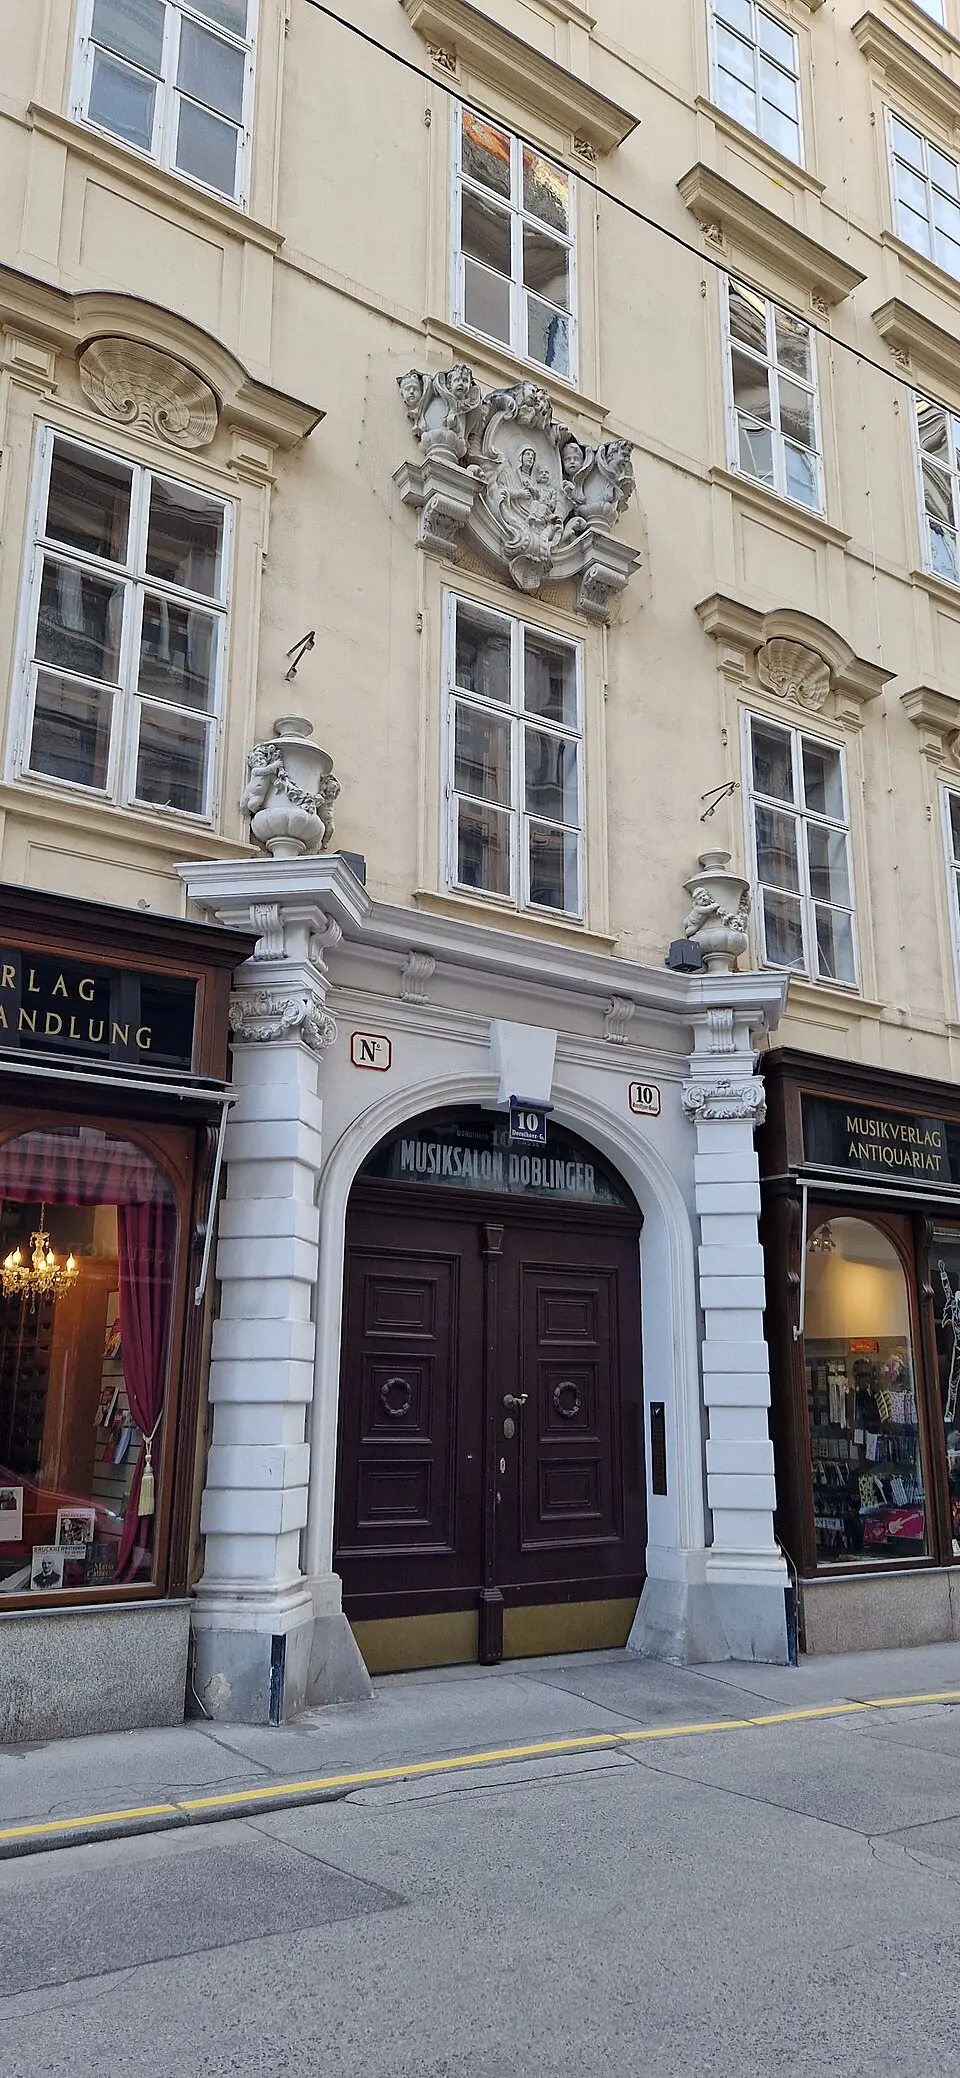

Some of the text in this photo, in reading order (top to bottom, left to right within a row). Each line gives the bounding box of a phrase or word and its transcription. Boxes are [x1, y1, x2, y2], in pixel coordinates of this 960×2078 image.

[0, 964, 95, 1001] RLAG
[636, 1086, 653, 1104] 10
[517, 1112, 539, 1131] 10
[846, 1115, 941, 1147] MUSIKVERLAG
[401, 1140, 596, 1193] MUSIKSALON DOBLINGER
[848, 1141, 941, 1171] ANTIQUARIAT
